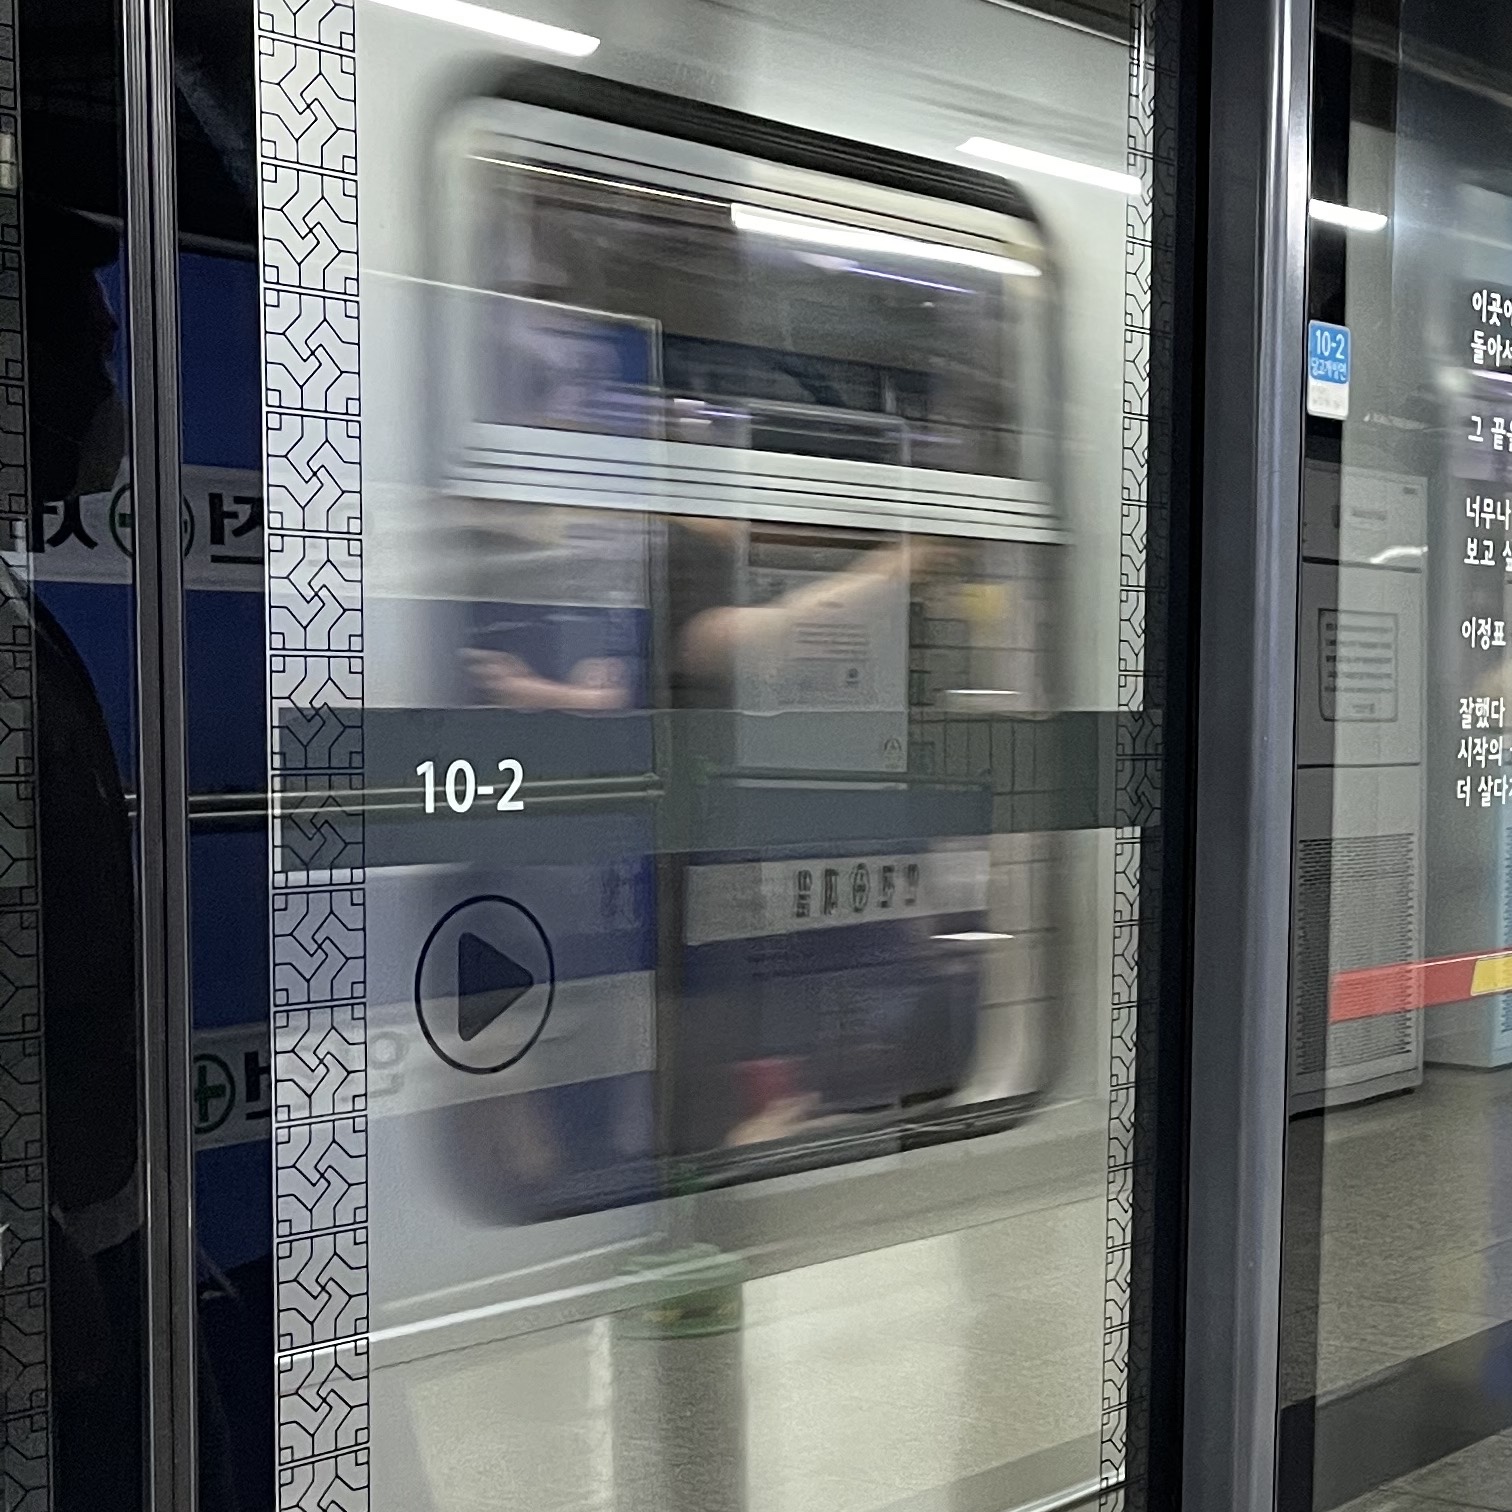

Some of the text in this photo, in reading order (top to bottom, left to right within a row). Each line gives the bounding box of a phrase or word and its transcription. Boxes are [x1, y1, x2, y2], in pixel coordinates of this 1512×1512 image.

[1315, 329, 1345, 360] 10-2
[1467, 415, 1485, 443] 그
[1465, 495, 1512, 531] 너무나
[1463, 536, 1497, 567] 보고
[1461, 616, 1507, 651] 이정표
[1458, 696, 1506, 730] 잘했다
[1457, 735, 1504, 769] 시작의
[416, 758, 525, 814] 10-2
[1456, 775, 1472, 807] 더
